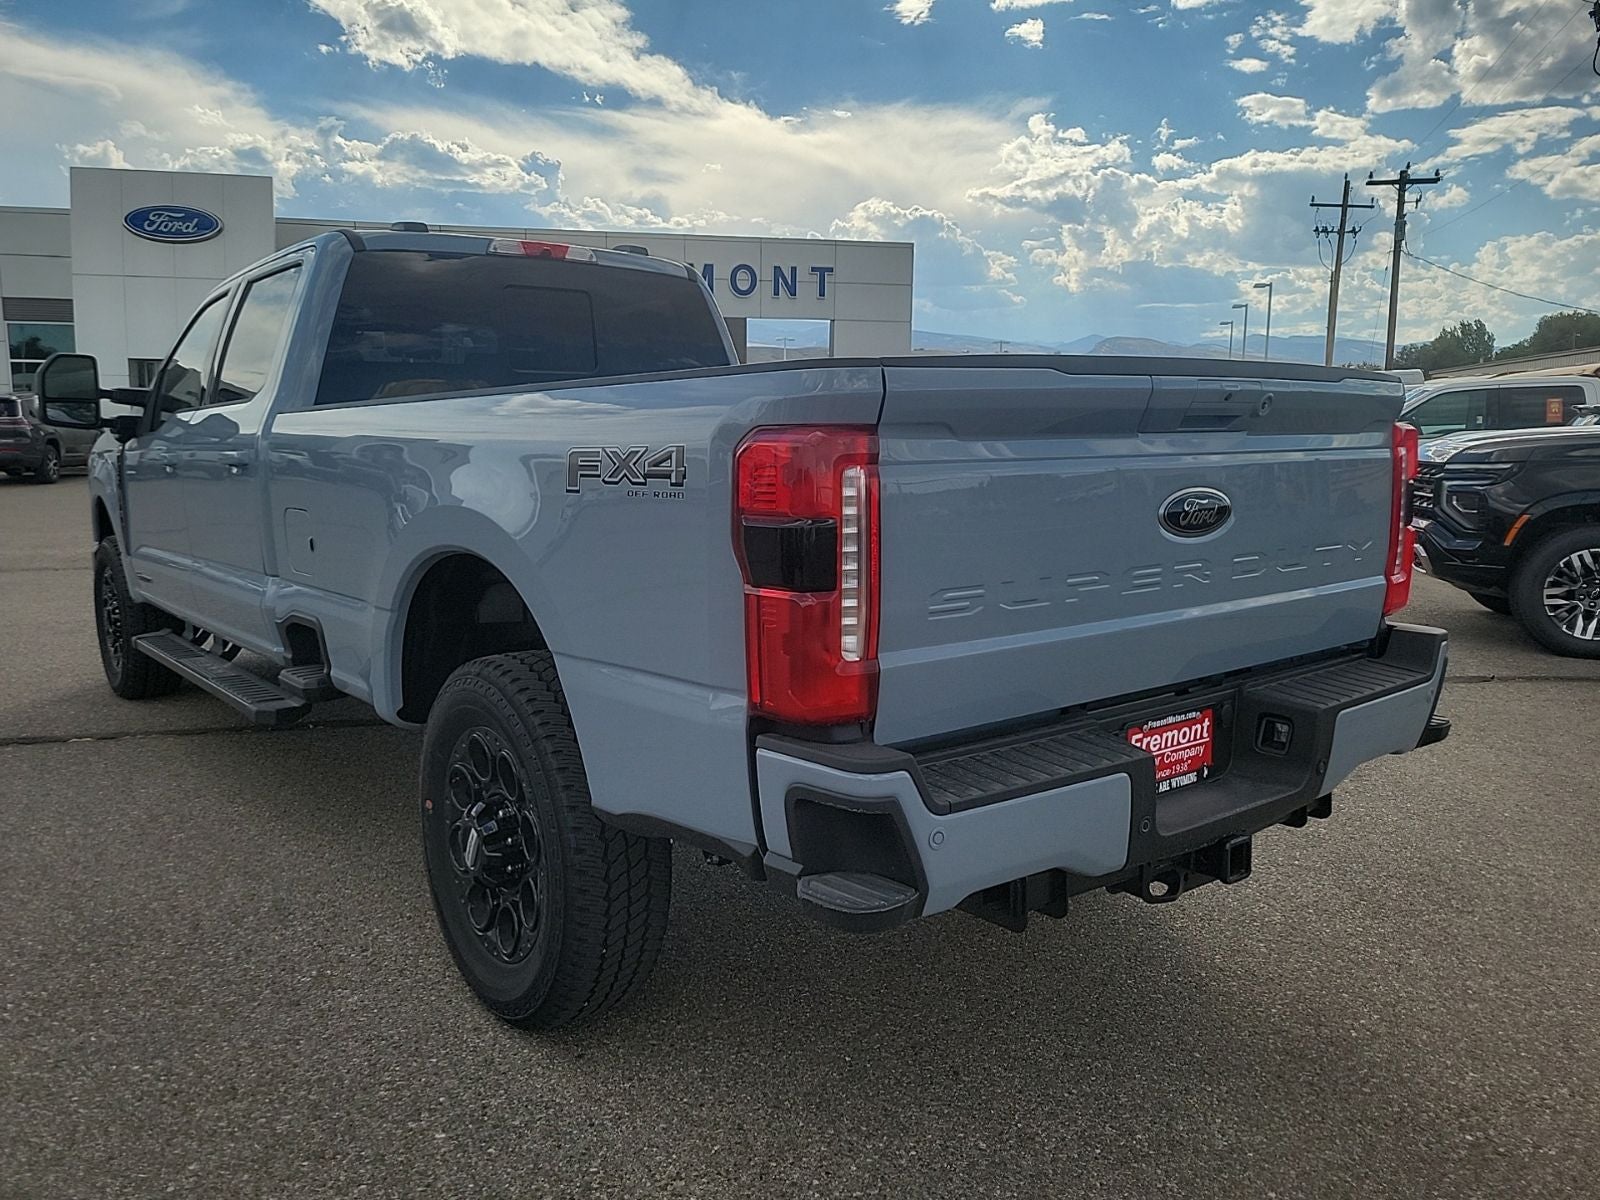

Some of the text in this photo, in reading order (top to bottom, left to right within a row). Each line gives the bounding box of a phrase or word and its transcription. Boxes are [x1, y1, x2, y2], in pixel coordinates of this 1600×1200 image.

[143, 210, 199, 233] Ford
[566, 444, 687, 493] FX4
[627, 489, 685, 500] OFF ROAD
[1180, 498, 1219, 525] Ford
[928, 540, 1373, 620] SUPER DUTY
[1131, 718, 1210, 751] Fremont
[1164, 745, 1206, 764] Company
